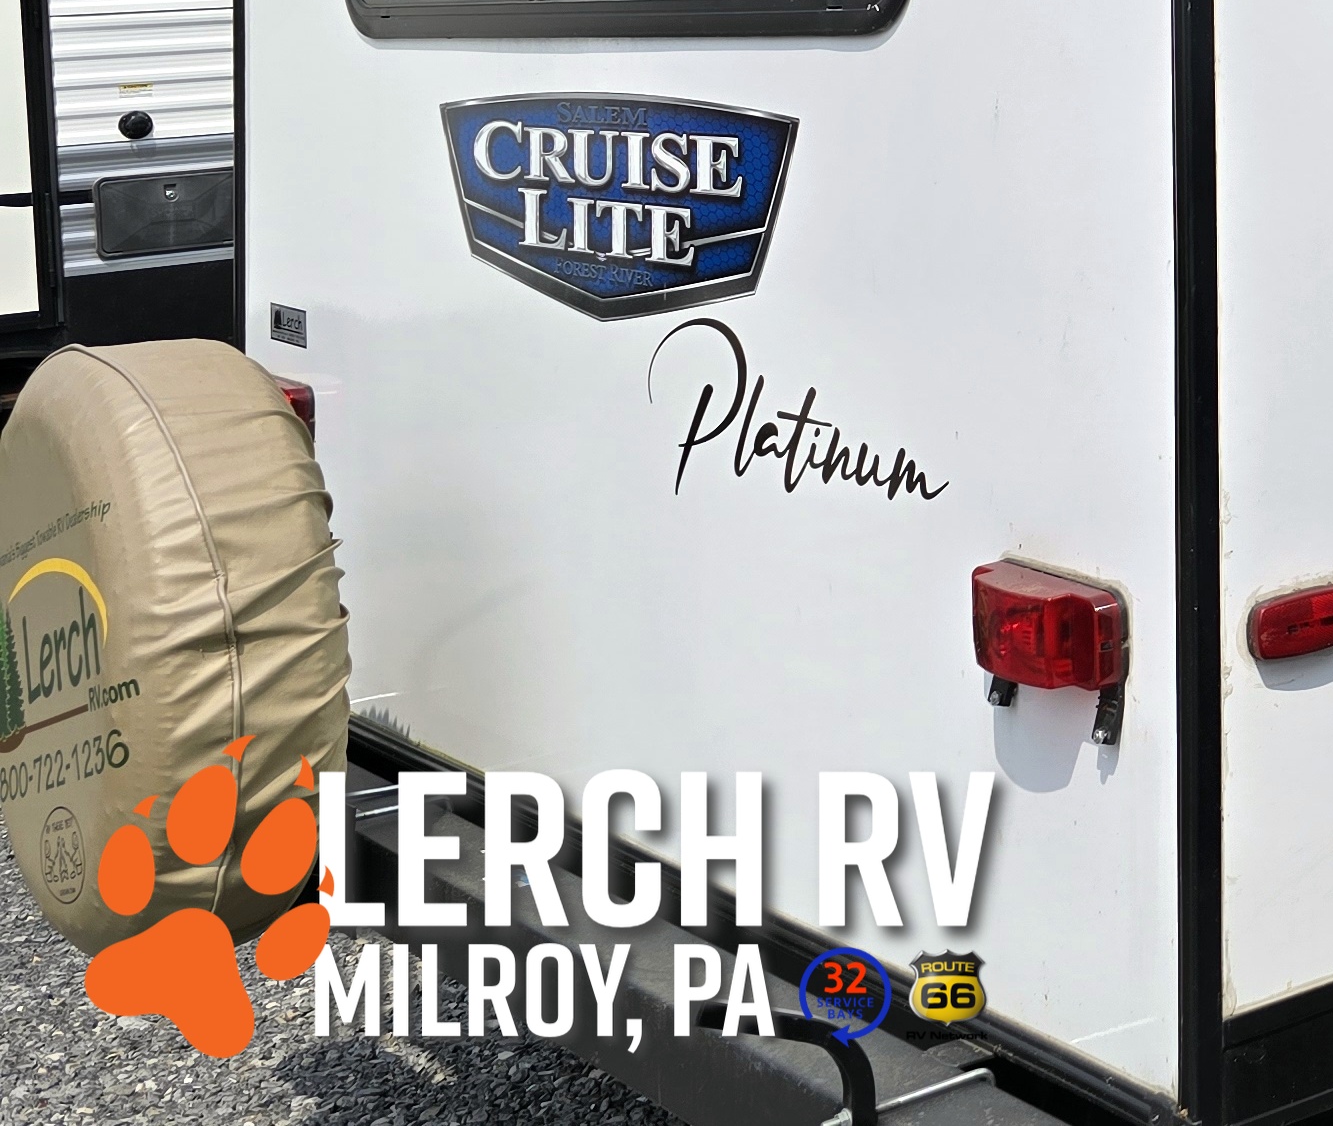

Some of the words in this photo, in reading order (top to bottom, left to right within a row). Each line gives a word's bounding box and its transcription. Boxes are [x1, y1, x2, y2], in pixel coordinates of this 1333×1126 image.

[556, 102, 648, 126] SALEM
[473, 120, 743, 198] CRUISE
[518, 187, 695, 267] LITE
[553, 257, 608, 281] FOREST
[609, 262, 654, 288] RIVER
[648, 318, 949, 500] Platinum
[22, 585, 100, 705] Lerch
[88, 678, 141, 712] RV.com
